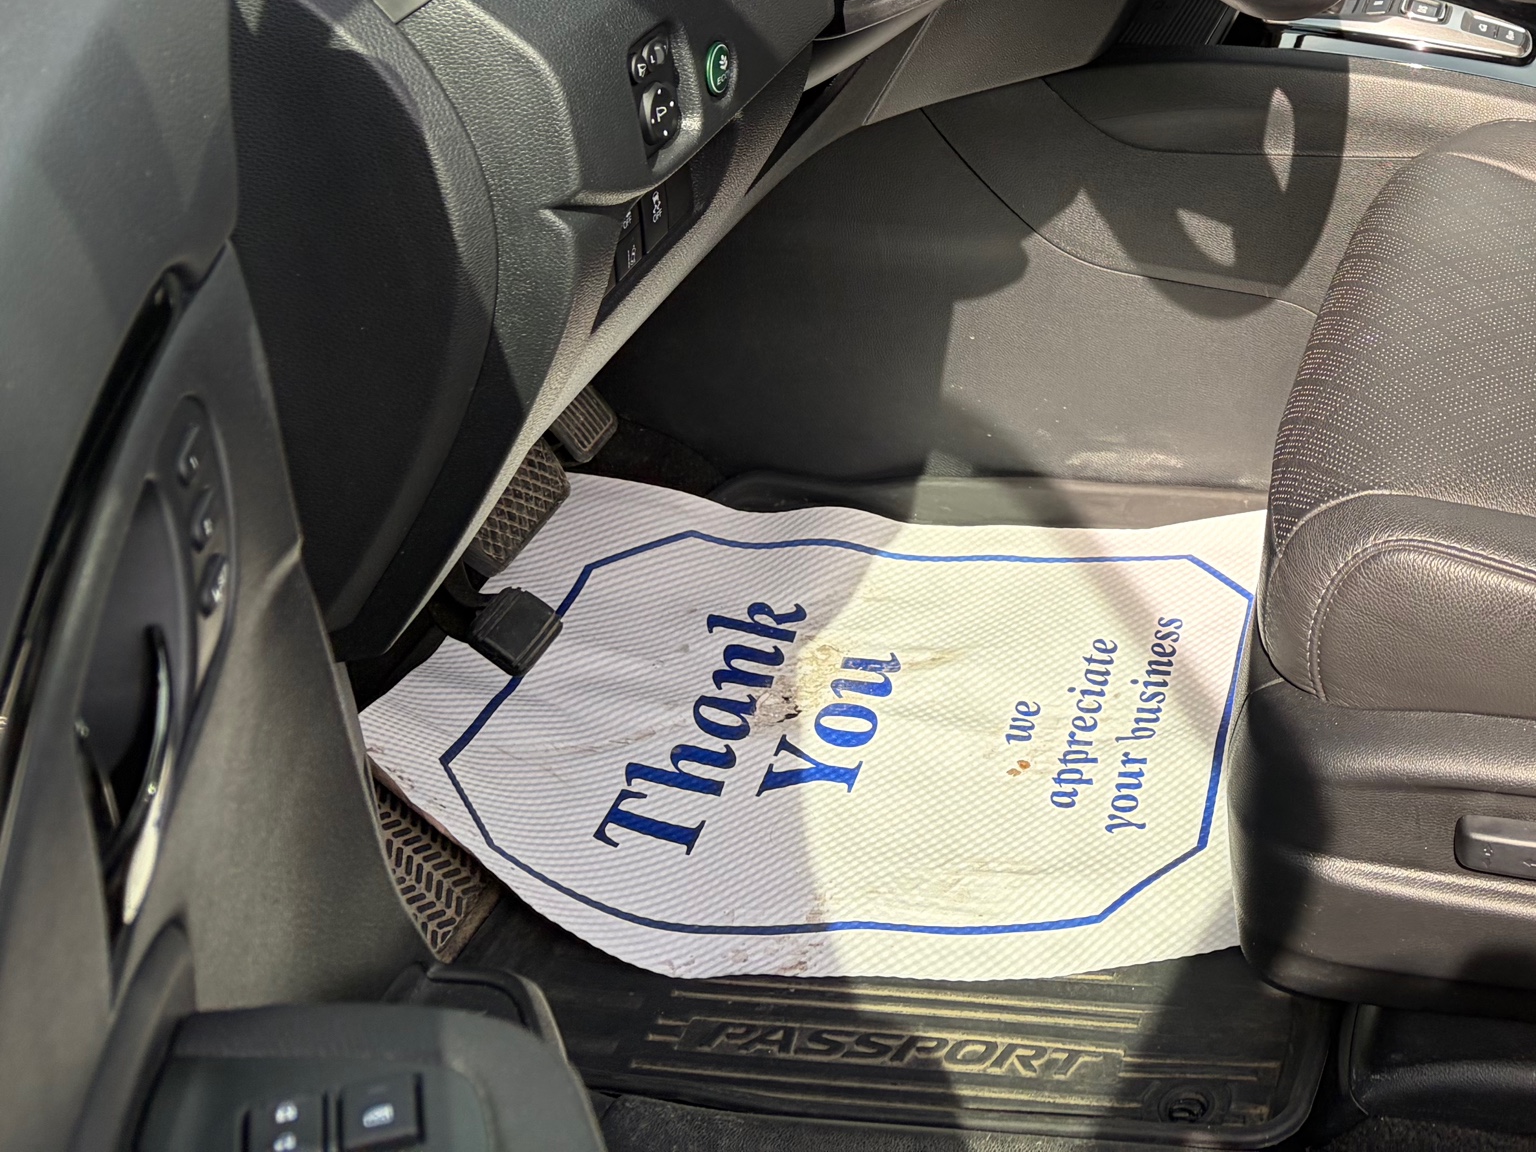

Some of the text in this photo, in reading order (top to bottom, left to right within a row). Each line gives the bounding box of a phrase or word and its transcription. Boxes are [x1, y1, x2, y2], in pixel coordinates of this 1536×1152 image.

[593, 602, 807, 855] Thank
[755, 652, 901, 797] You
[1005, 701, 1041, 744] we
[1050, 638, 1118, 809] appreciate
[1104, 616, 1183, 834] your business
[703, 1021, 1105, 1079] PASSPORT
